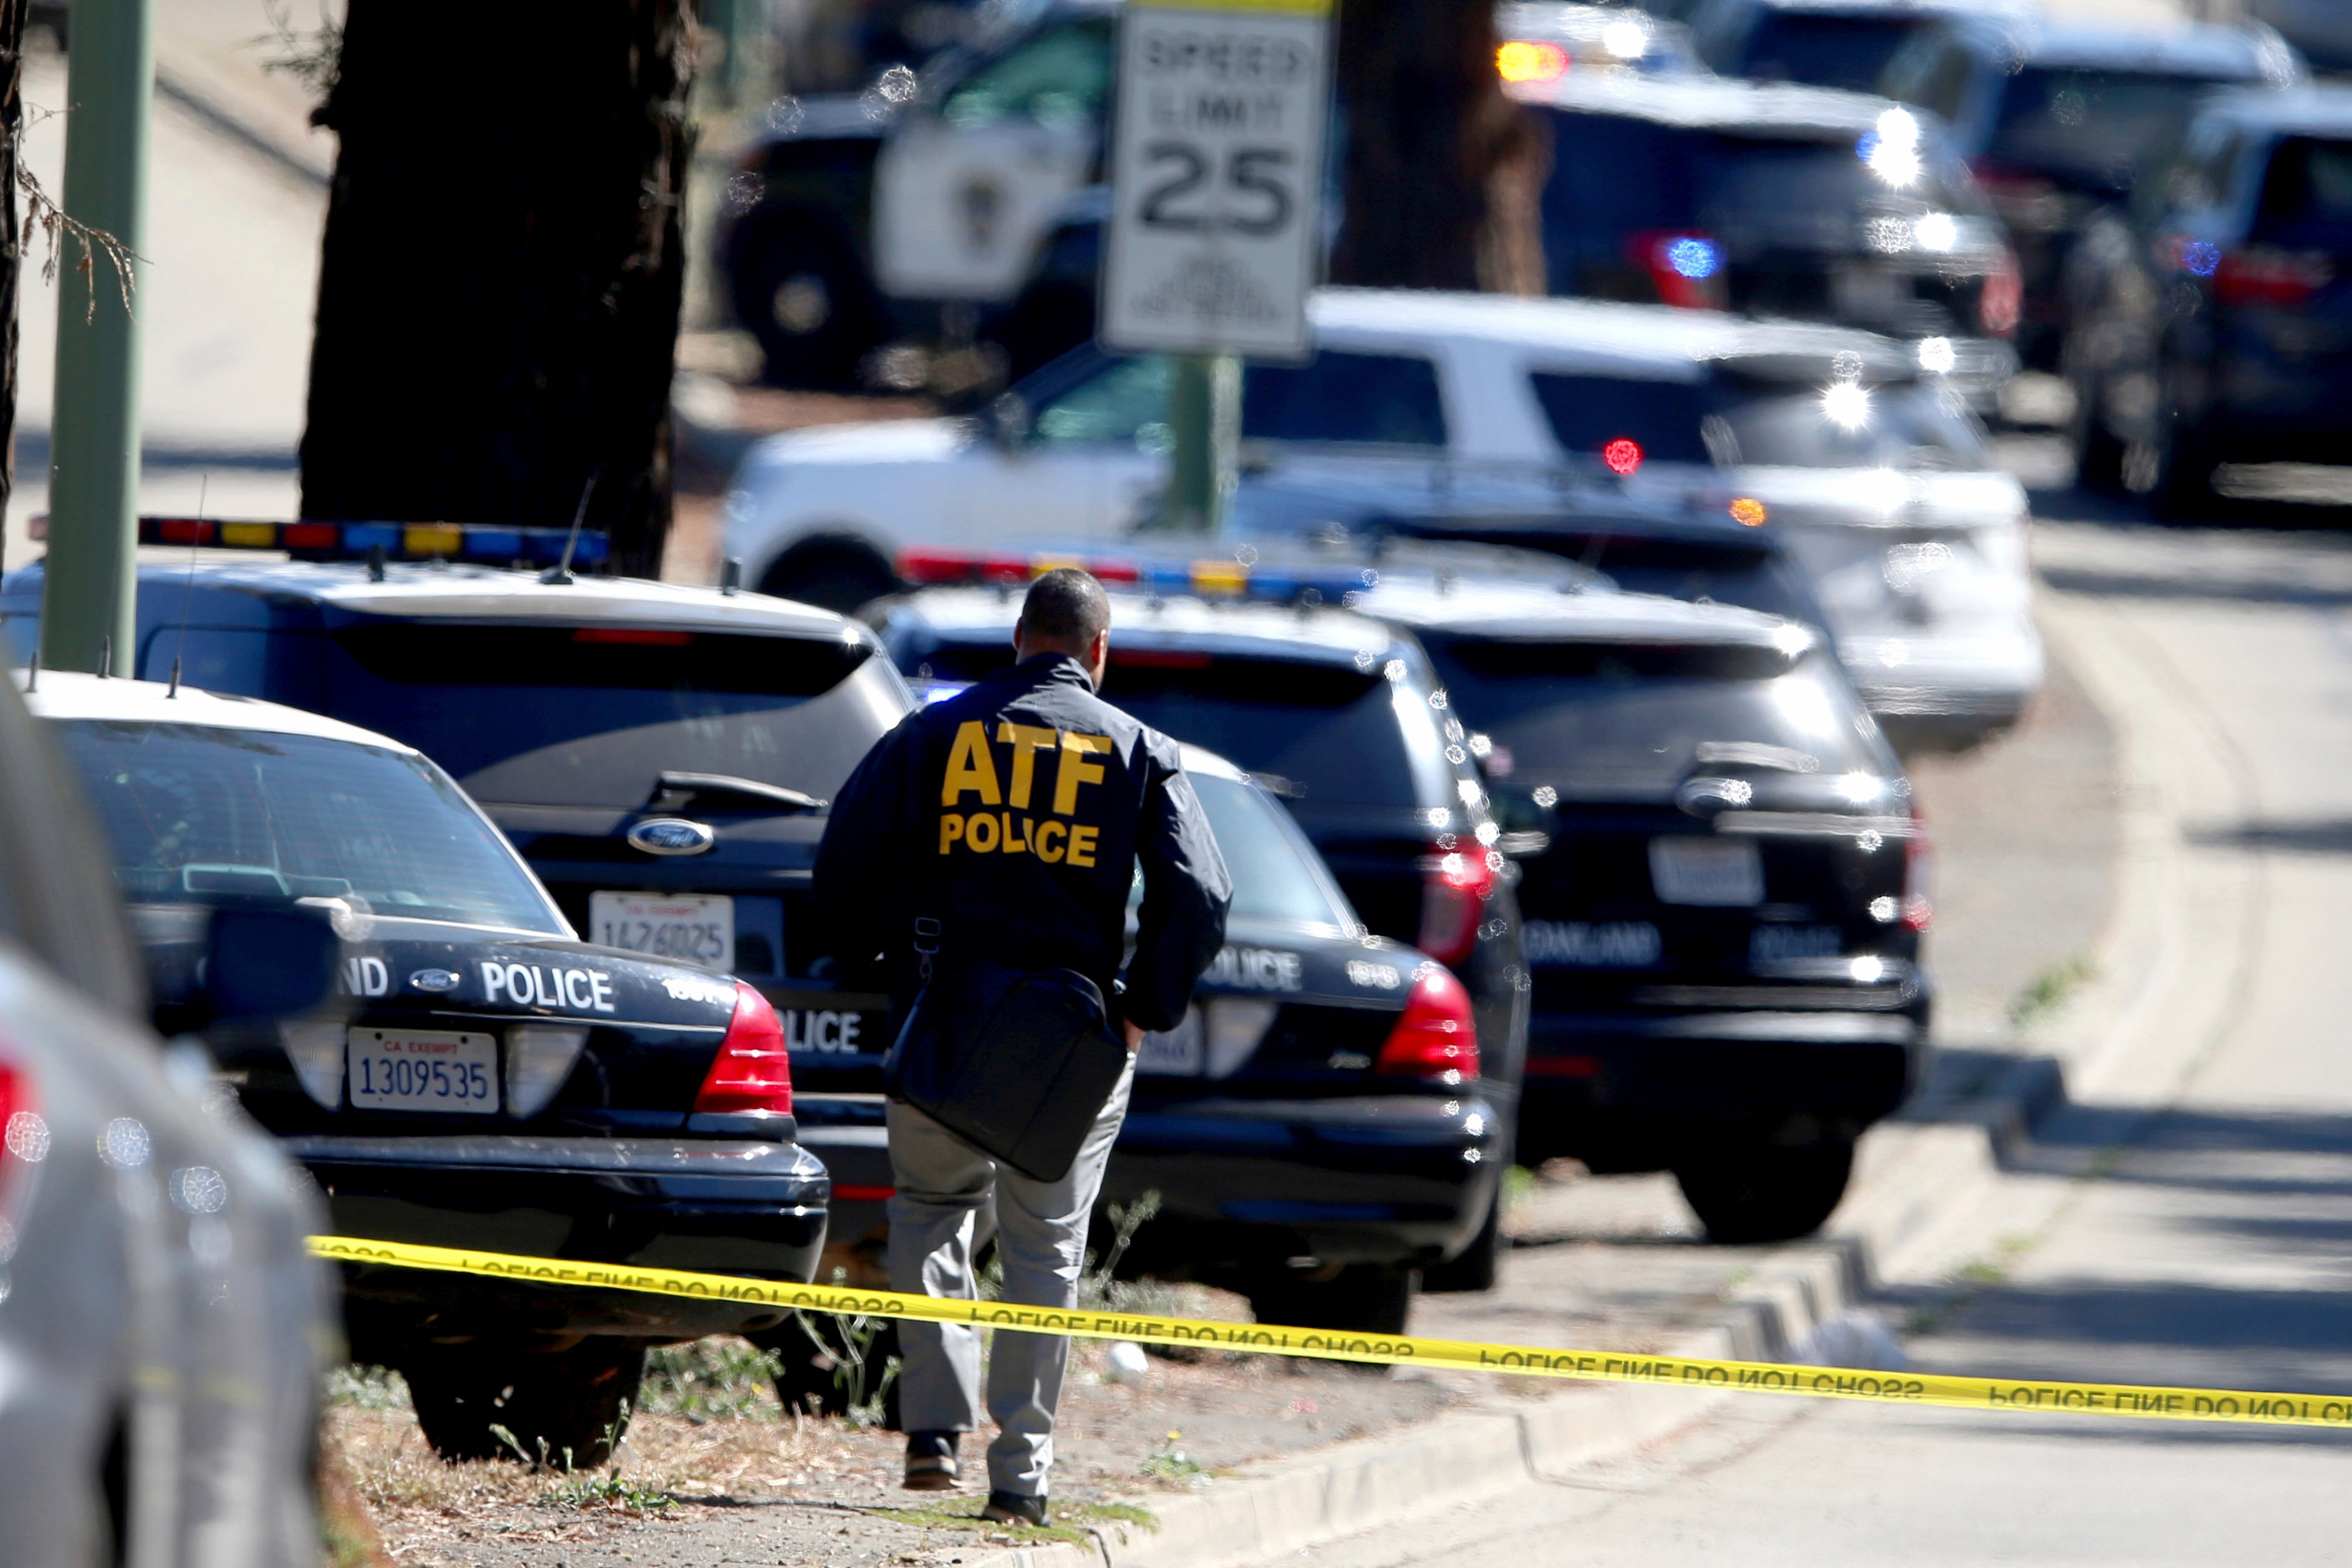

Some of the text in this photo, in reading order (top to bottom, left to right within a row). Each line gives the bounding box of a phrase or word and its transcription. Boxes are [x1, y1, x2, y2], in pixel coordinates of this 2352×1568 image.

[1138, 141, 1294, 236] 25
[941, 720, 1112, 816] ATF
[939, 812, 1099, 868] POLICE
[481, 962, 614, 1012] POLICE
[384, 1041, 459, 1055] CA EXEMPT
[775, 1009, 861, 1054] LICE
[361, 1058, 487, 1099] 1309535
